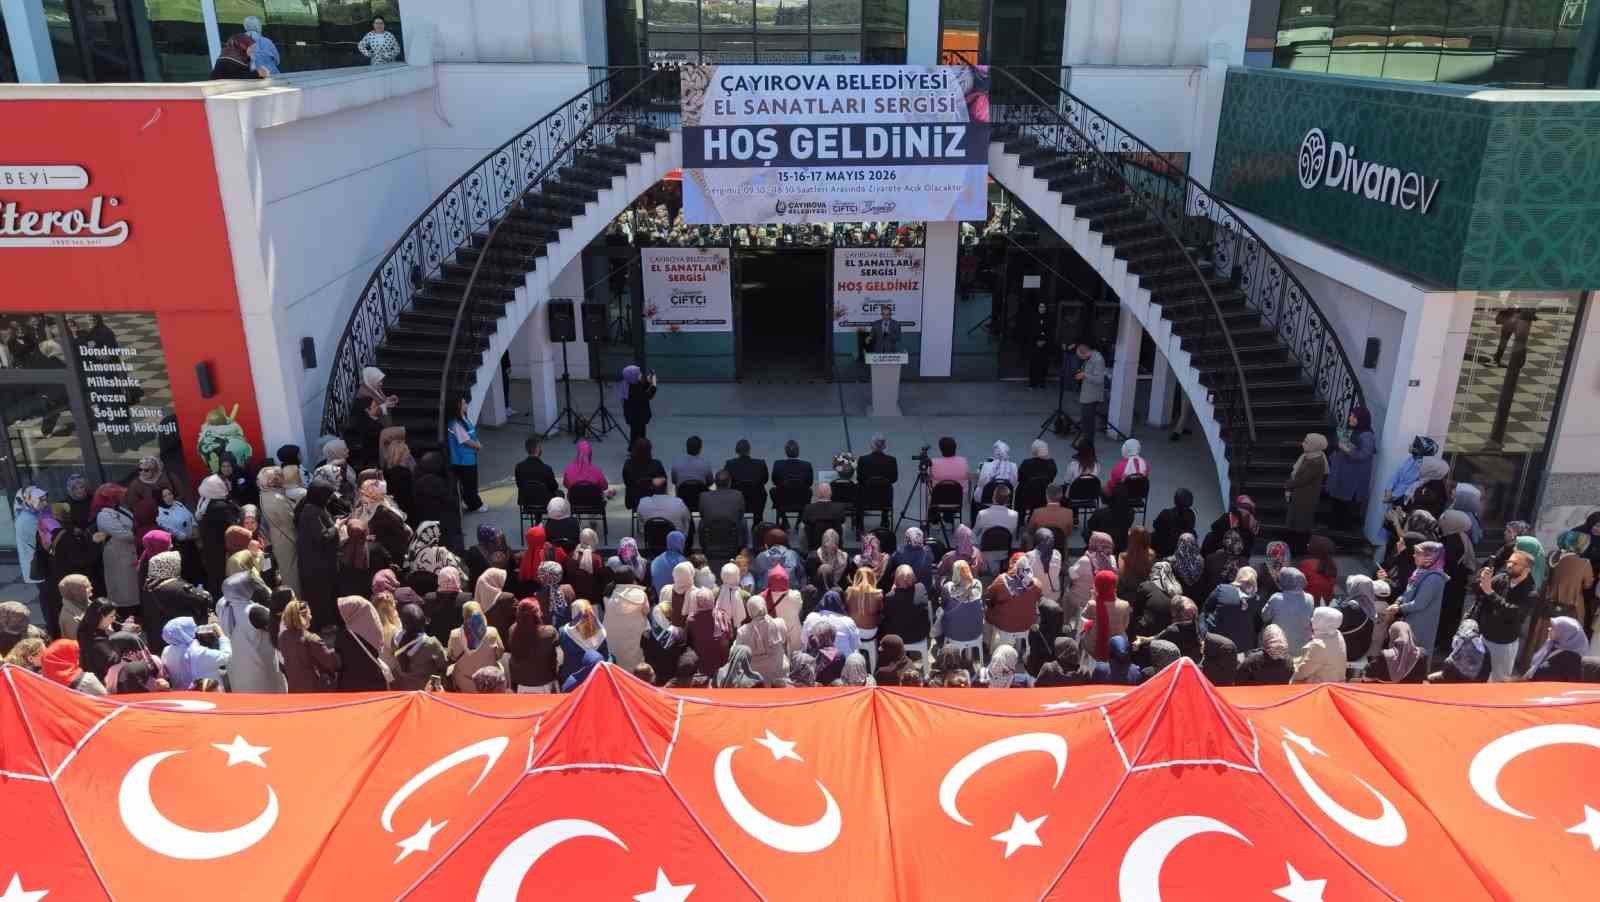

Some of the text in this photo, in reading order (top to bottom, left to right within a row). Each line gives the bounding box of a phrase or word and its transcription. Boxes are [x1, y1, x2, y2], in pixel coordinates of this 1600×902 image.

[720, 70, 948, 96] ÇAYIROVA BELEDİYESİ
[714, 93, 956, 116] EL SANATLARI SERGİSİ
[703, 128, 778, 166] HOŞ
[778, 170, 897, 182] 15-16-17 MAYIS 2026
[1325, 141, 1440, 215] Divanev
[650, 263, 722, 272] EL SANATLARI
[845, 258, 913, 267] EL SANATLARI
[860, 268, 897, 277] SERGİSİ
[837, 279, 920, 294] HOŞ GELDİNİZ
[86, 376, 141, 388] Milkshake
[90, 391, 127, 403] Frozen
[93, 406, 128, 420] Soğuk
